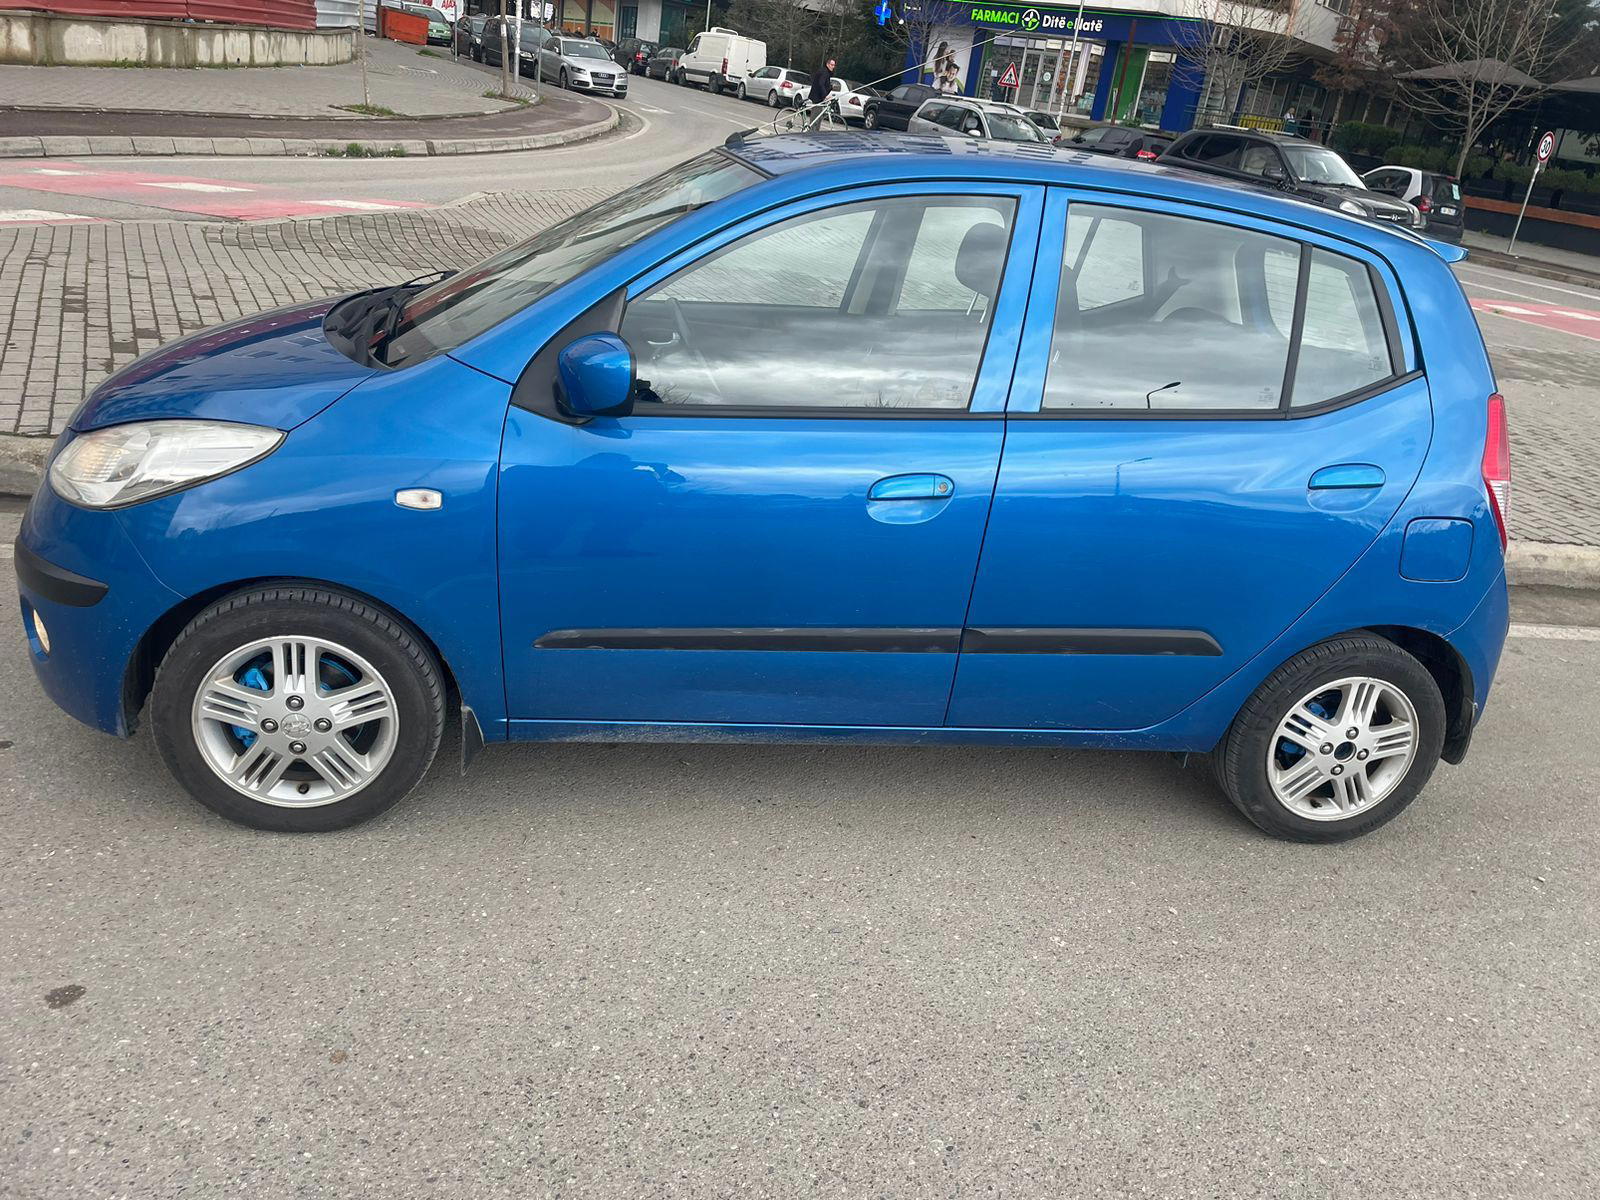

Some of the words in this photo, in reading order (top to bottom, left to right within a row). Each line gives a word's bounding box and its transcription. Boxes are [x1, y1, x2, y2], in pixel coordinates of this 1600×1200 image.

[971, 9, 1019, 24] FARMACI
[1042, 15, 1066, 28] Ditë
[1067, 20, 1073, 29] e
[1074, 18, 1102, 31] Natë
[1541, 139, 1551, 154] 30
